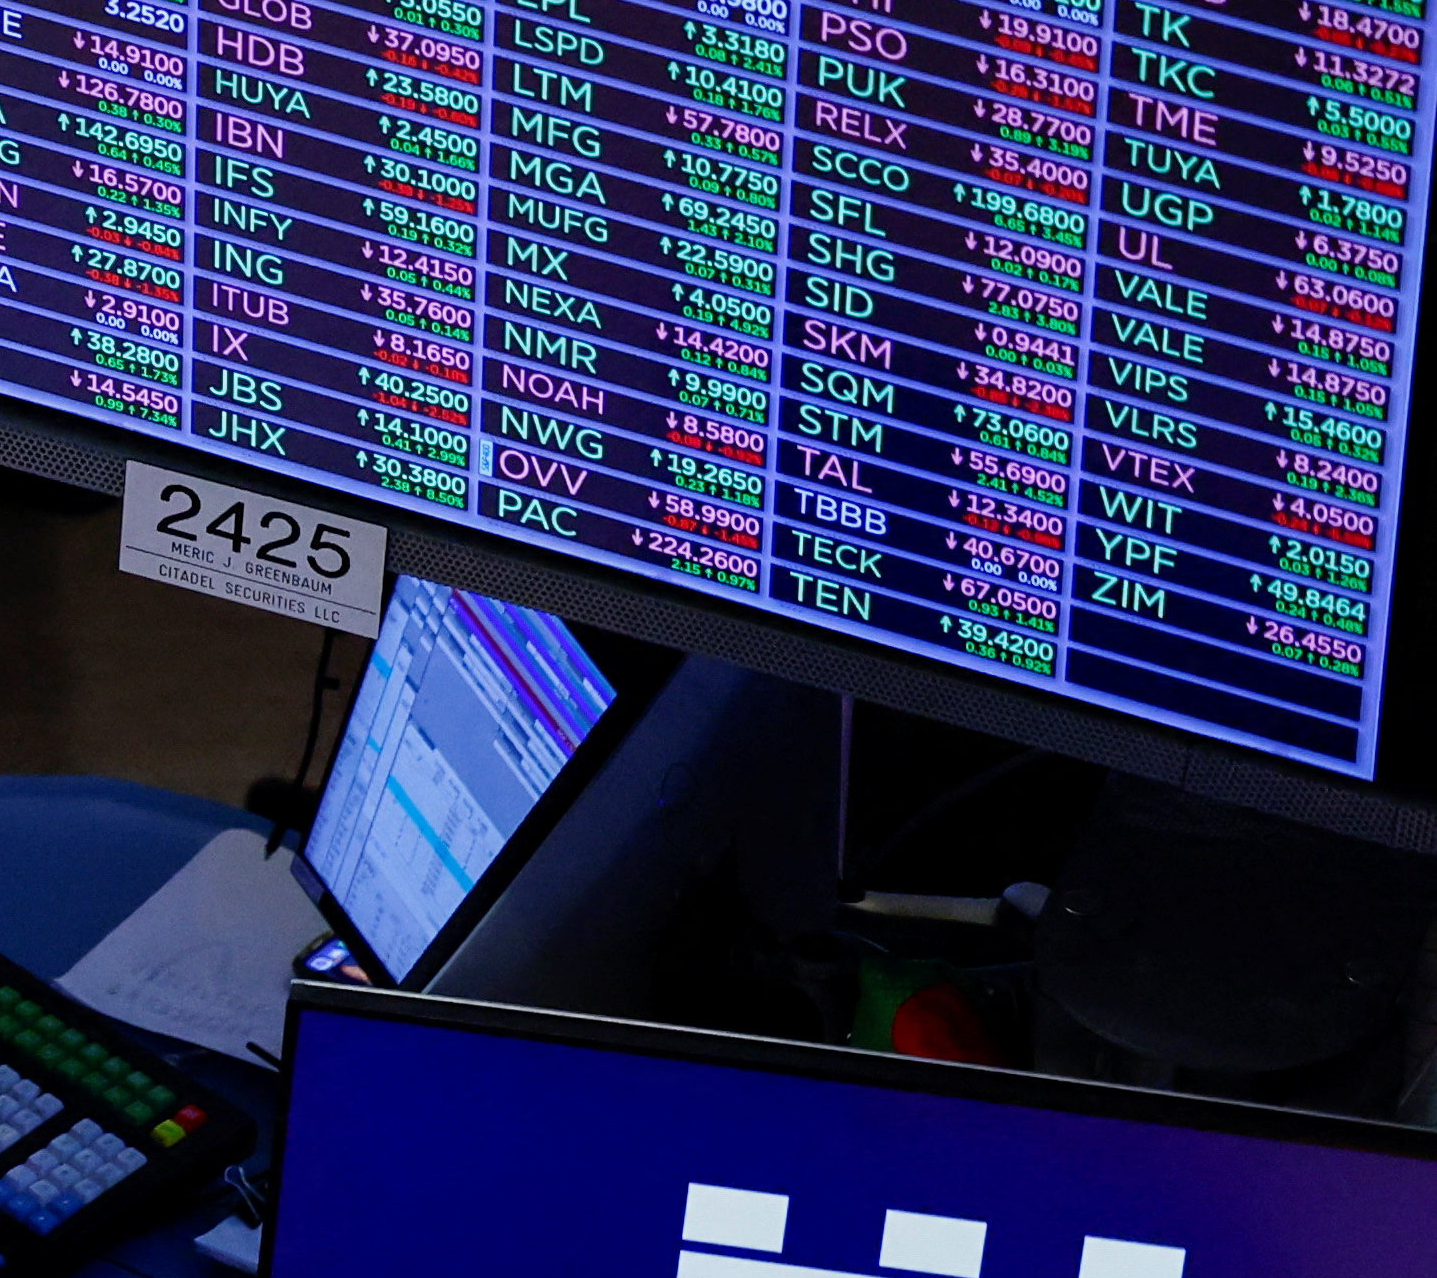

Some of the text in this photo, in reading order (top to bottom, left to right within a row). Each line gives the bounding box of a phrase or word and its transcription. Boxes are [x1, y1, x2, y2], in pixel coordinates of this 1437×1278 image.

[1132, 47, 1410, 140] TKC 5.5000
[501, 405, 761, 495] NWG 19.2650
[156, 484, 351, 579] 2425
[171, 541, 214, 565] MERIC
[245, 562, 332, 596] GREENBAUM
[498, 489, 757, 578] PAC 224.2600
[159, 564, 340, 624] CITADEL SECURITIES LLC
